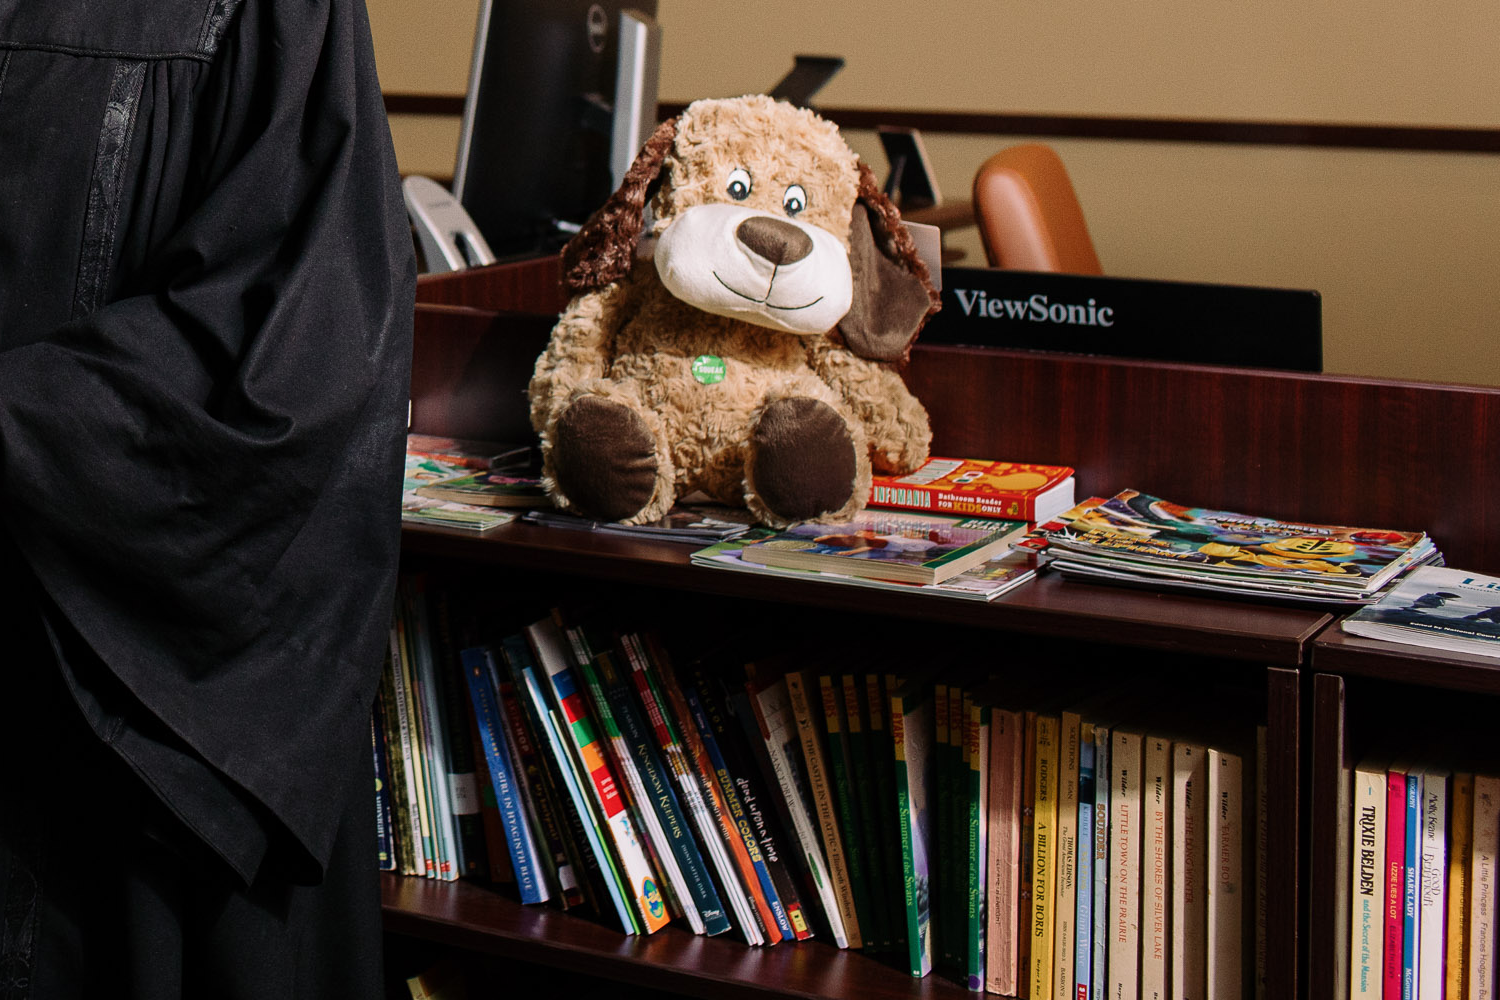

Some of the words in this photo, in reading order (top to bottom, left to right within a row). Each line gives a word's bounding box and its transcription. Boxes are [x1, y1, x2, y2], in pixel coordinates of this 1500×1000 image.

[954, 288, 1114, 327] ViewSonic
[874, 486, 931, 508] INFOMANIA
[938, 493, 974, 503] Bathroom
[976, 494, 1002, 505] Reader
[938, 501, 952, 509] FOR
[953, 502, 982, 513] KIDS
[1444, 627, 1475, 635] National
[893, 713, 904, 745] BYARS
[970, 722, 980, 755] BYARS
[805, 738, 815, 754] THE
[496, 770, 509, 794] GIRL
[768, 749, 786, 782] NANCY
[780, 782, 796, 809] DREW
[809, 755, 823, 789] CASTLE
[1039, 758, 1048, 801] RODGERS
[502, 796, 513, 809] IN
[635, 742, 666, 795] KINGDOM
[657, 794, 685, 840] KEEPERS
[817, 790, 826, 800] IN
[899, 791, 907, 806] The
[1067, 780, 1075, 800] EGAN
[1428, 792, 1438, 814] Molly
[705, 787, 723, 822] ETERNITY
[715, 767, 743, 818] SUMMER
[736, 818, 762, 863] COLORS
[819, 801, 830, 819] THE
[1156, 811, 1164, 821] BY
[734, 774, 756, 804] dead
[758, 835, 781, 865] time
[900, 807, 912, 850] Summer
[1038, 822, 1046, 830] A
[1097, 803, 1106, 859] SOUNDER
[1121, 804, 1129, 834] LITTLE
[1186, 816, 1194, 834] THE
[1359, 805, 1376, 846] TRIXIE
[1428, 816, 1438, 841] Keane
[506, 810, 526, 864] HYACINTH
[824, 820, 837, 849] ATTIC
[970, 819, 980, 862] Summer
[1155, 828, 1163, 844] THE
[1222, 825, 1230, 863] FARMER
[903, 851, 912, 860] of
[1037, 833, 1046, 875] BILLION
[1120, 836, 1128, 865] TOWN
[1186, 837, 1194, 866] LONG
[519, 865, 533, 891] BLUE
[904, 861, 913, 873] the
[970, 864, 977, 875] of
[1120, 868, 1128, 883] ON
[1155, 846, 1163, 884] SHORES
[1222, 866, 1230, 886] BOY
[1361, 849, 1375, 896] BELDEN
[1482, 863, 1490, 881] Little
[905, 875, 916, 906] Swans
[1036, 879, 1045, 900] FOR
[1120, 886, 1128, 904] THE
[1155, 887, 1163, 901] OF
[1185, 868, 1194, 904] WINTER
[1481, 883, 1489, 915] Princess
[772, 901, 789, 931] ENSLOW
[968, 892, 979, 919] Swans
[1078, 903, 1089, 934] Giant
[1154, 902, 1163, 933] SILVER
[1363, 899, 1371, 911] and
[1363, 912, 1371, 922] the
[1035, 904, 1044, 937] BORIS
[1119, 907, 1128, 942] PRAIRIE
[1362, 923, 1371, 944] Secret
[1154, 935, 1163, 959] LAKE
[1480, 922, 1488, 952] Frances
[1078, 938, 1087, 967] Wave
[1362, 953, 1370, 963] the
[1361, 965, 1370, 992] Mansion
[1478, 954, 1487, 987] Hodgson
